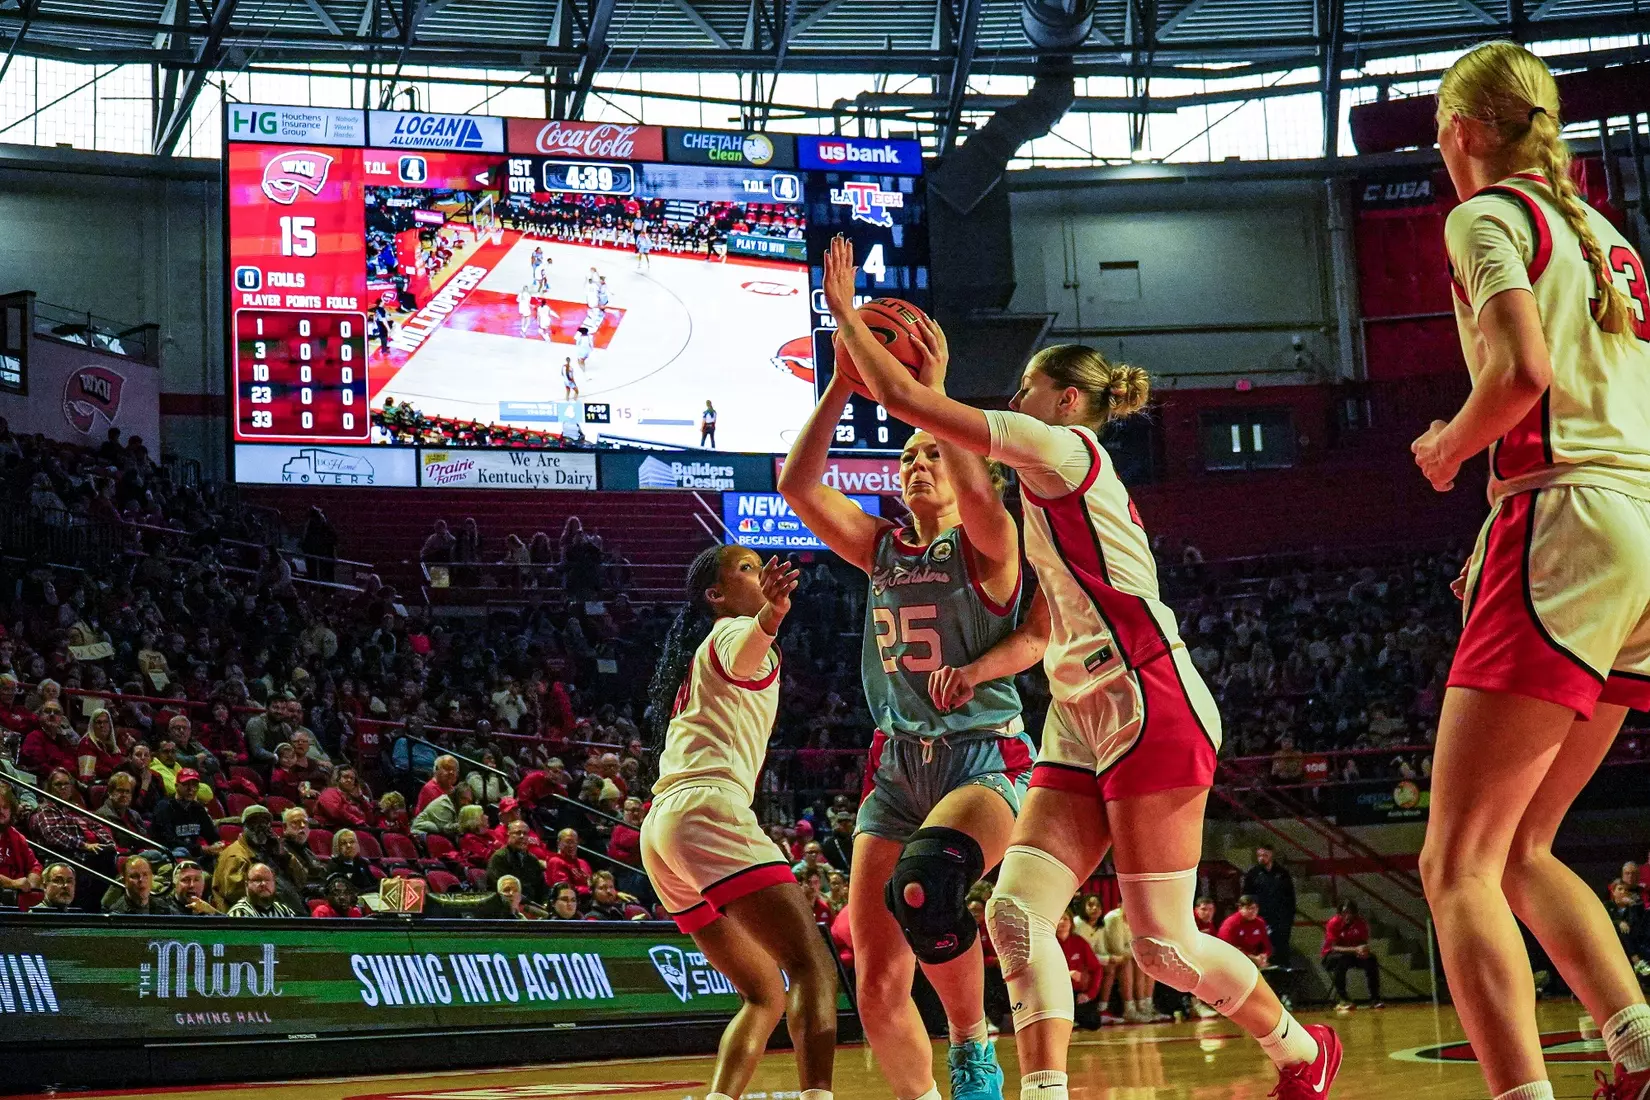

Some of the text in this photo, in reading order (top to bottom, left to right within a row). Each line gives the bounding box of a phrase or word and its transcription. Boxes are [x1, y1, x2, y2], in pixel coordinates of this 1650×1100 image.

[234, 110, 277, 135] HIG
[281, 111, 322, 121] Houchens
[281, 120, 321, 130] Insurance
[281, 128, 307, 137] Group
[394, 116, 461, 137] LOGAN
[389, 136, 454, 148] ALUMINUM
[535, 120, 640, 158] Coca-Cola
[683, 133, 743, 150] CHEETAH
[708, 148, 743, 162] Clean
[281, 160, 316, 179] WKU
[406, 158, 422, 181] 4
[508, 159, 532, 176] 1ST
[565, 166, 613, 191] 4:39
[780, 178, 794, 198] 4
[280, 216, 317, 257] 15
[736, 238, 785, 253] PLAY TO WIN
[863, 244, 886, 283] 4
[244, 270, 305, 288] 0 FOULS
[242, 293, 358, 310] PLAYER POINTS FOULS
[387, 265, 488, 352] HILLTOPPERS
[256, 318, 352, 338] 1 0 0
[255, 342, 352, 361] 3 0 0
[253, 364, 353, 384] 10 0 0
[79, 374, 112, 404] WKU
[251, 386, 353, 406] 23 0 0
[251, 410, 354, 430] 33 0 0
[616, 407, 632, 419] 15
[876, 404, 888, 421] 0
[835, 424, 889, 443] 23 0
[425, 458, 475, 477] Prairie
[508, 452, 561, 468] We Are
[671, 461, 735, 477] Builders
[282, 473, 375, 485] MOVERS
[434, 472, 467, 486] Farms
[477, 468, 593, 490] Kentucky's Dairy
[682, 475, 735, 492] Design
[738, 496, 796, 517] NEW
[738, 535, 785, 546] BECAUSE
[786, 535, 819, 547] LOCAL
[871, 603, 944, 675] 25
[148, 941, 283, 998] Mint
[350, 951, 615, 1007] SWING INTO ACTION
[139, 963, 151, 998] THE
[175, 1011, 272, 1026] GAMING HALL
